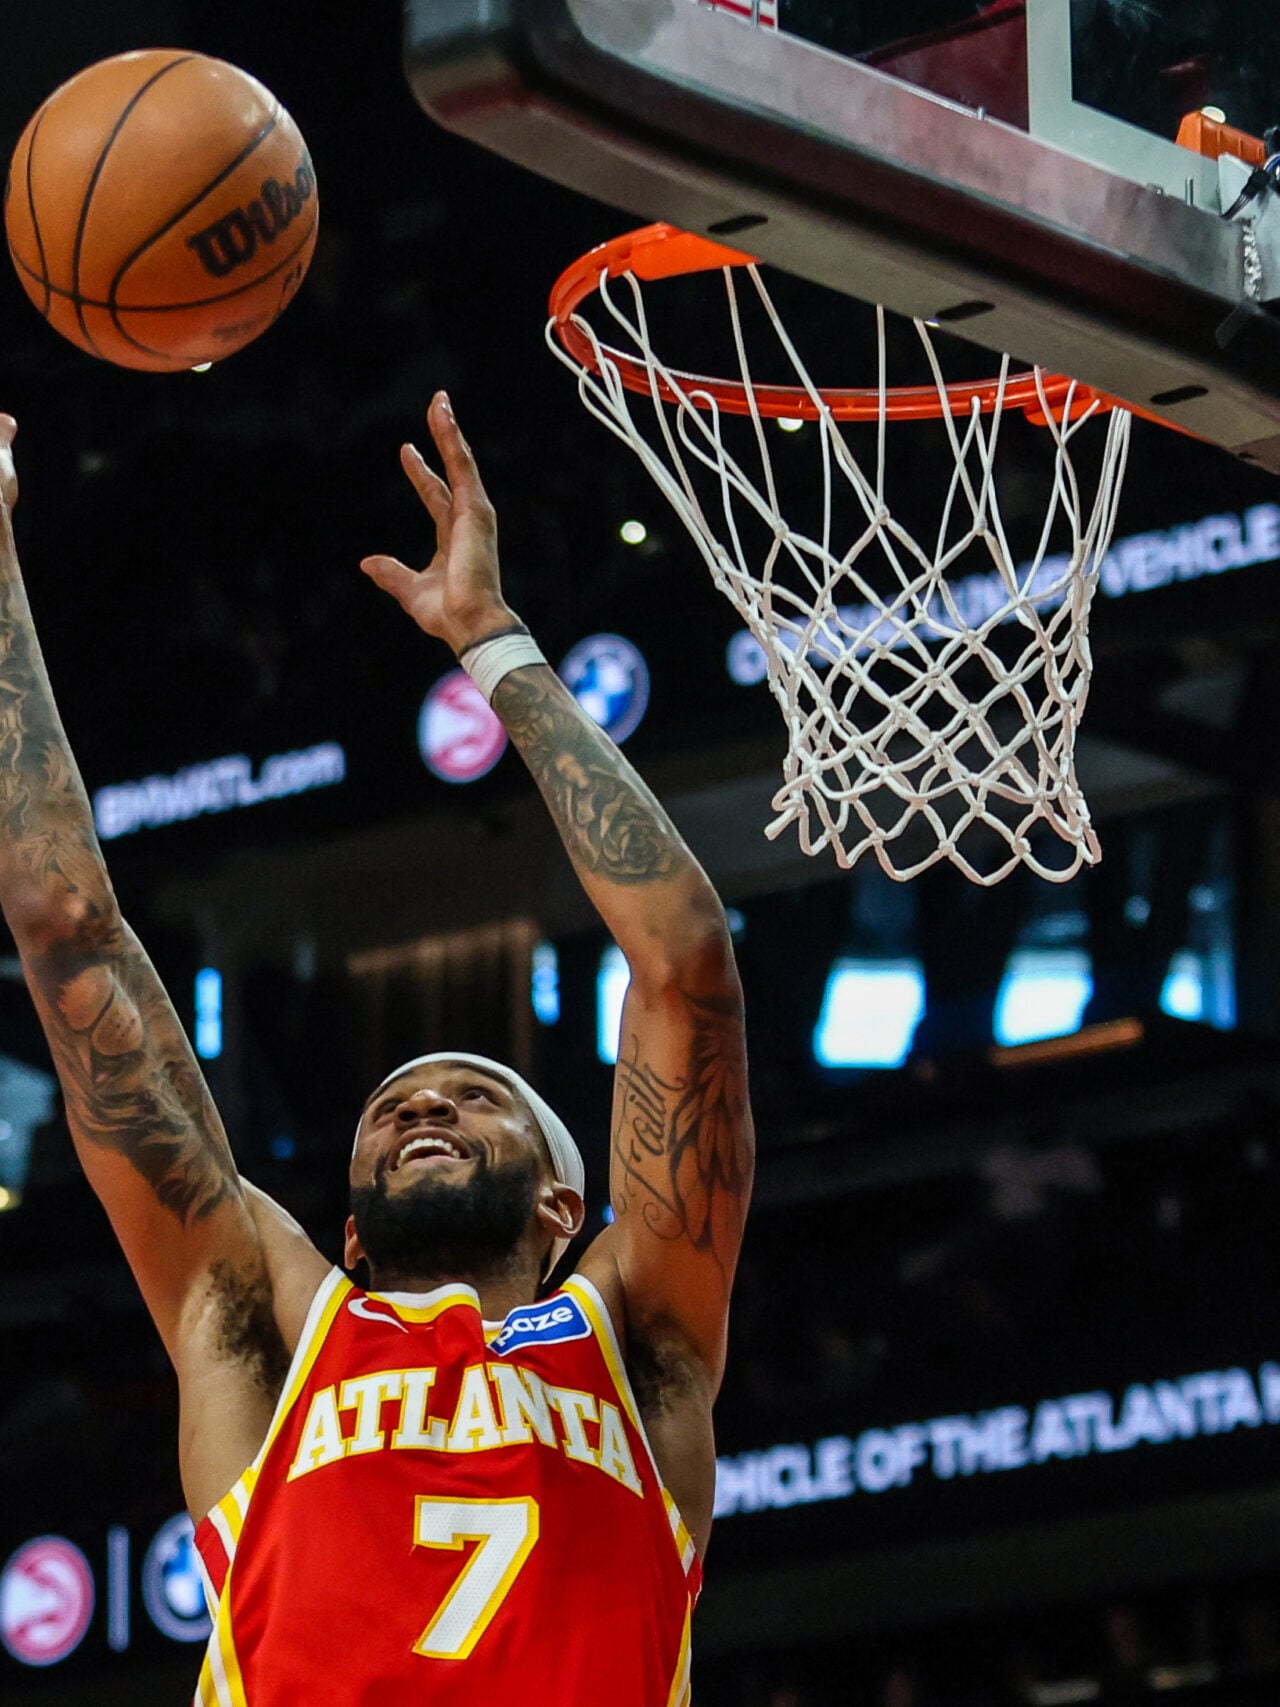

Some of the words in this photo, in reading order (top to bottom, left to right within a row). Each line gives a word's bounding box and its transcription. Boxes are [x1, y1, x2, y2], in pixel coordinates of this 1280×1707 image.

[186, 152, 317, 278] Wilso
[1092, 503, 1280, 598] VEHICLE
[286, 1362, 645, 1499] ATLANTA
[713, 1433, 853, 1519] HICLE
[854, 1425, 926, 1494] OF
[924, 1406, 1032, 1480] THE
[1030, 1366, 1261, 1464] ATLANTA
[412, 1494, 540, 1660] 7
